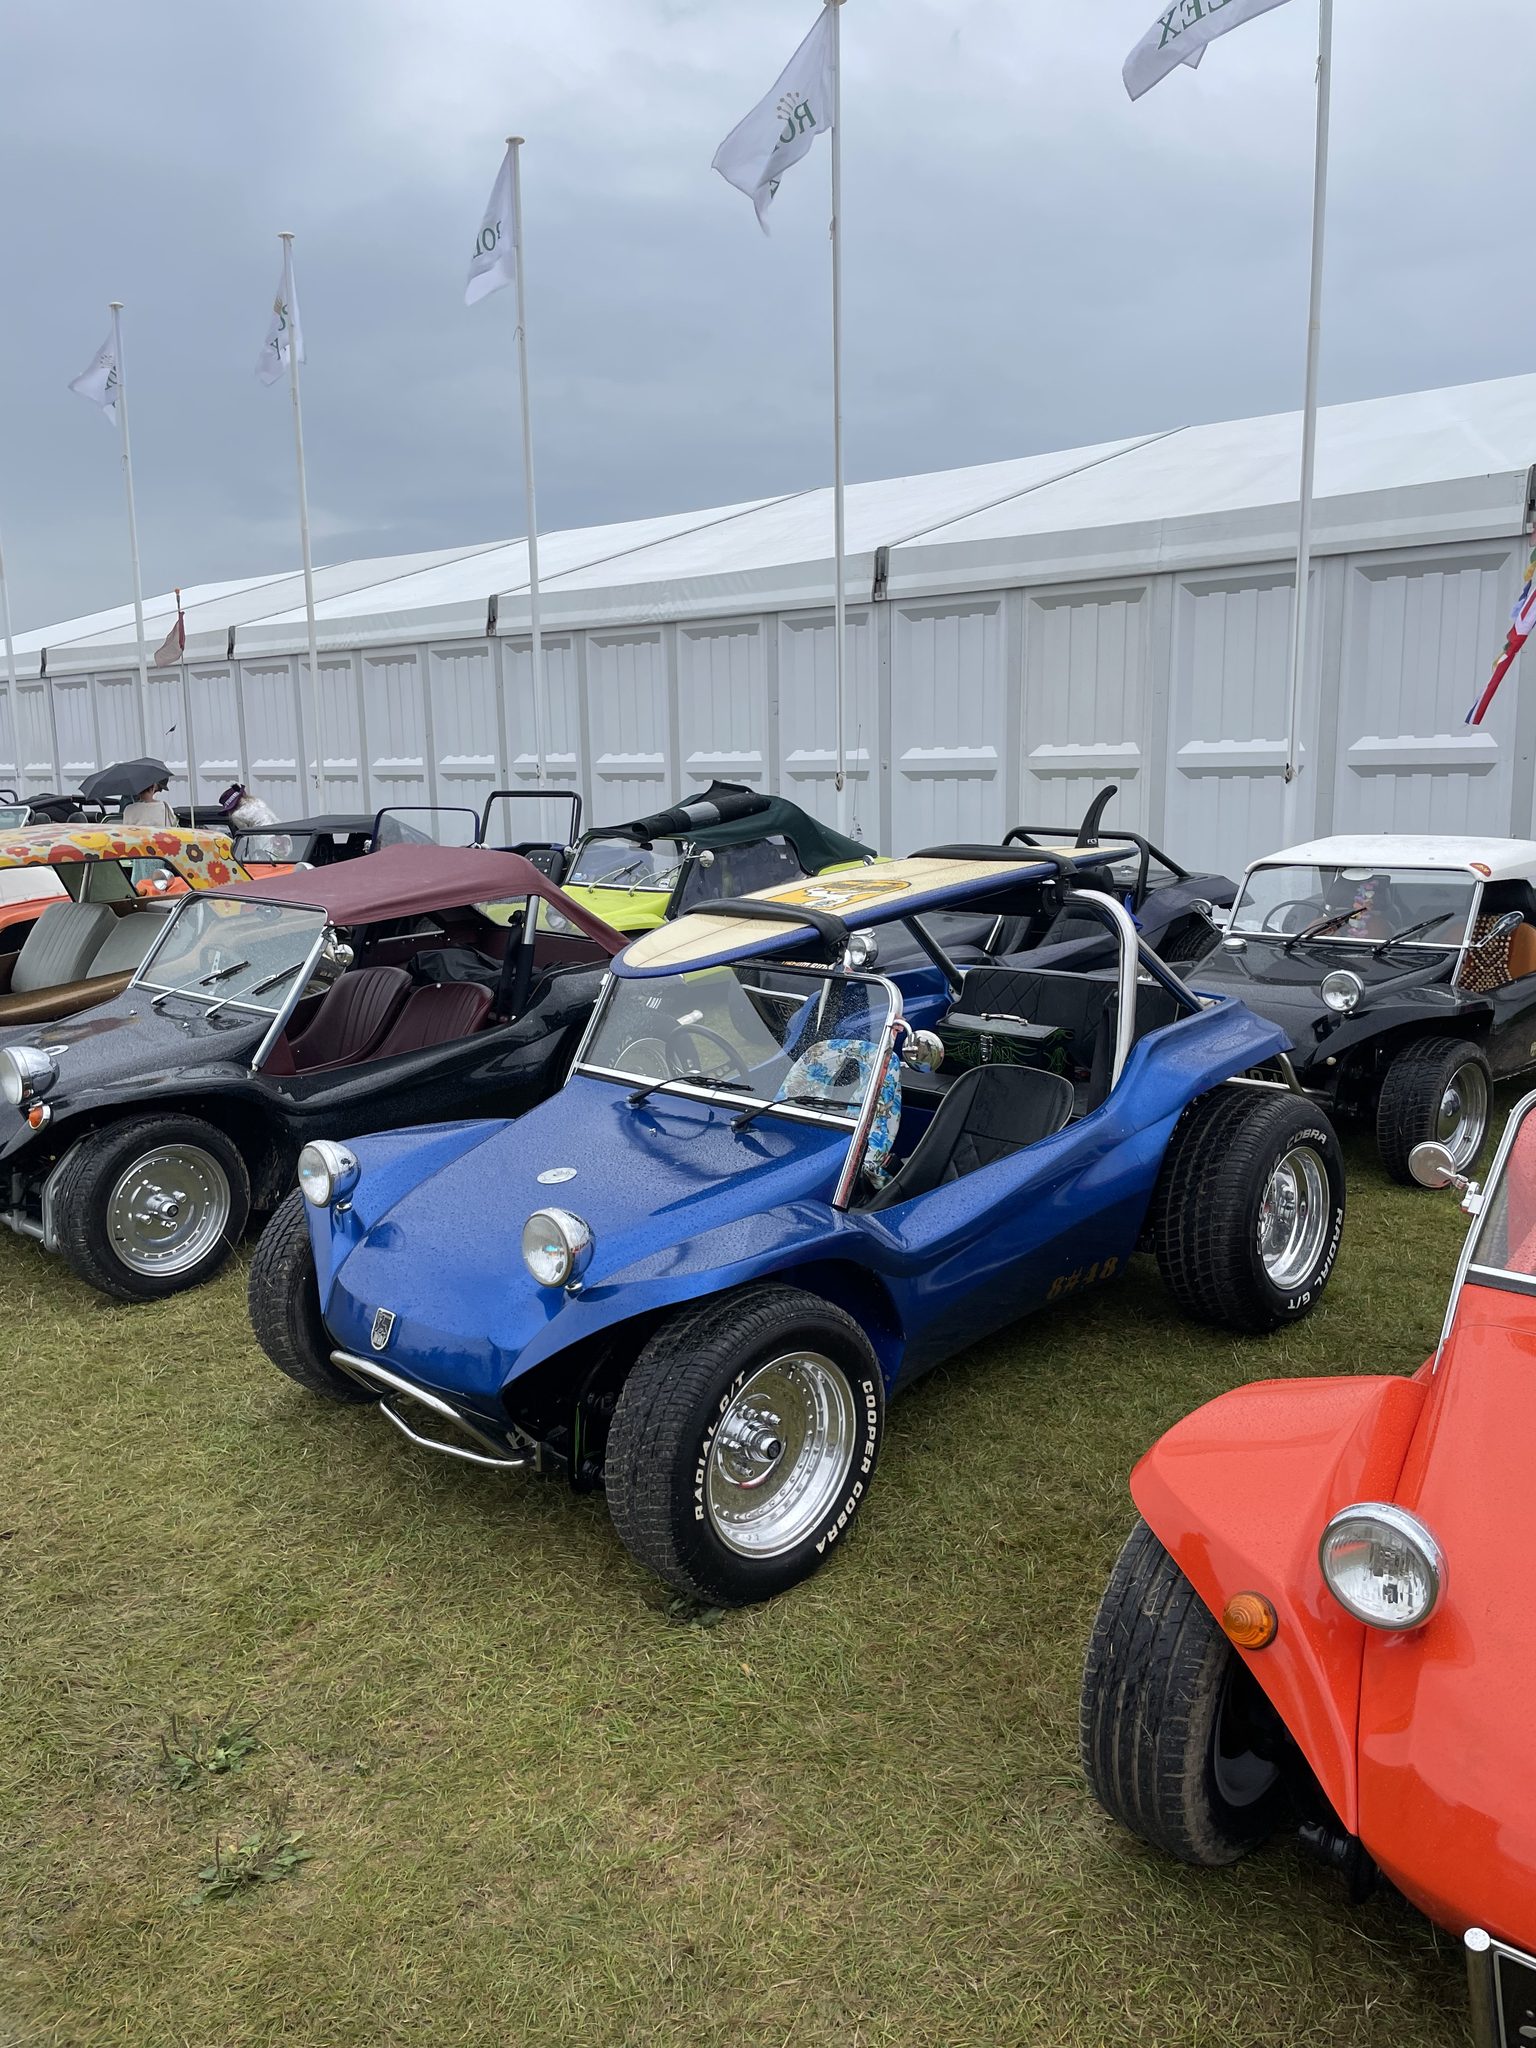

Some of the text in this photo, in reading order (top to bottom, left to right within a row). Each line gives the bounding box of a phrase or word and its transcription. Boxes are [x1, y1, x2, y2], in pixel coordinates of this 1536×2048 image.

[1286, 1128, 1327, 1149] COBRA
[1287, 1207, 1343, 1309] RADIAL G/T
[695, 1421, 718, 1520] RADIAL
[815, 1380, 877, 1554] COOPER COBRA
